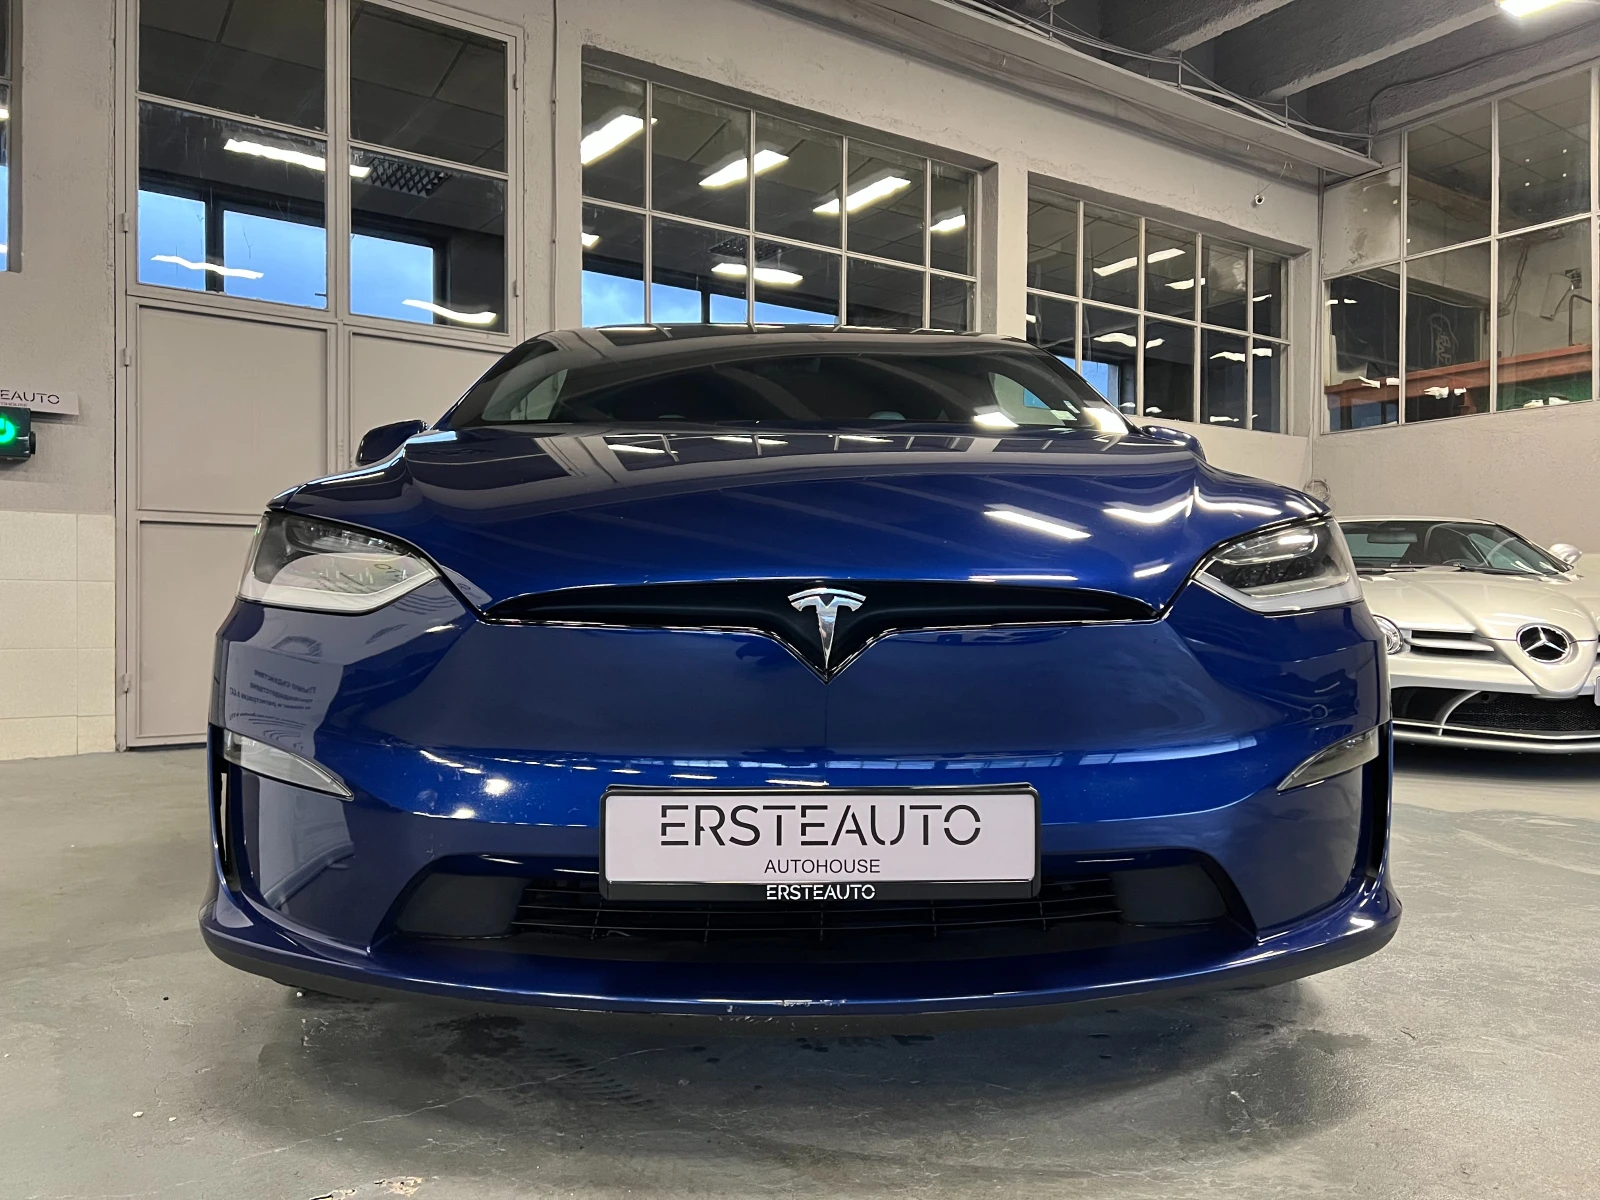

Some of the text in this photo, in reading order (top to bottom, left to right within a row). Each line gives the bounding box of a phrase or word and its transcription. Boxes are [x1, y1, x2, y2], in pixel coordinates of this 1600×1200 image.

[660, 804, 982, 847] ERSTEAUTO
[764, 859, 881, 874] AUTOHOUSE
[766, 884, 876, 901] ERSTEAUTO
